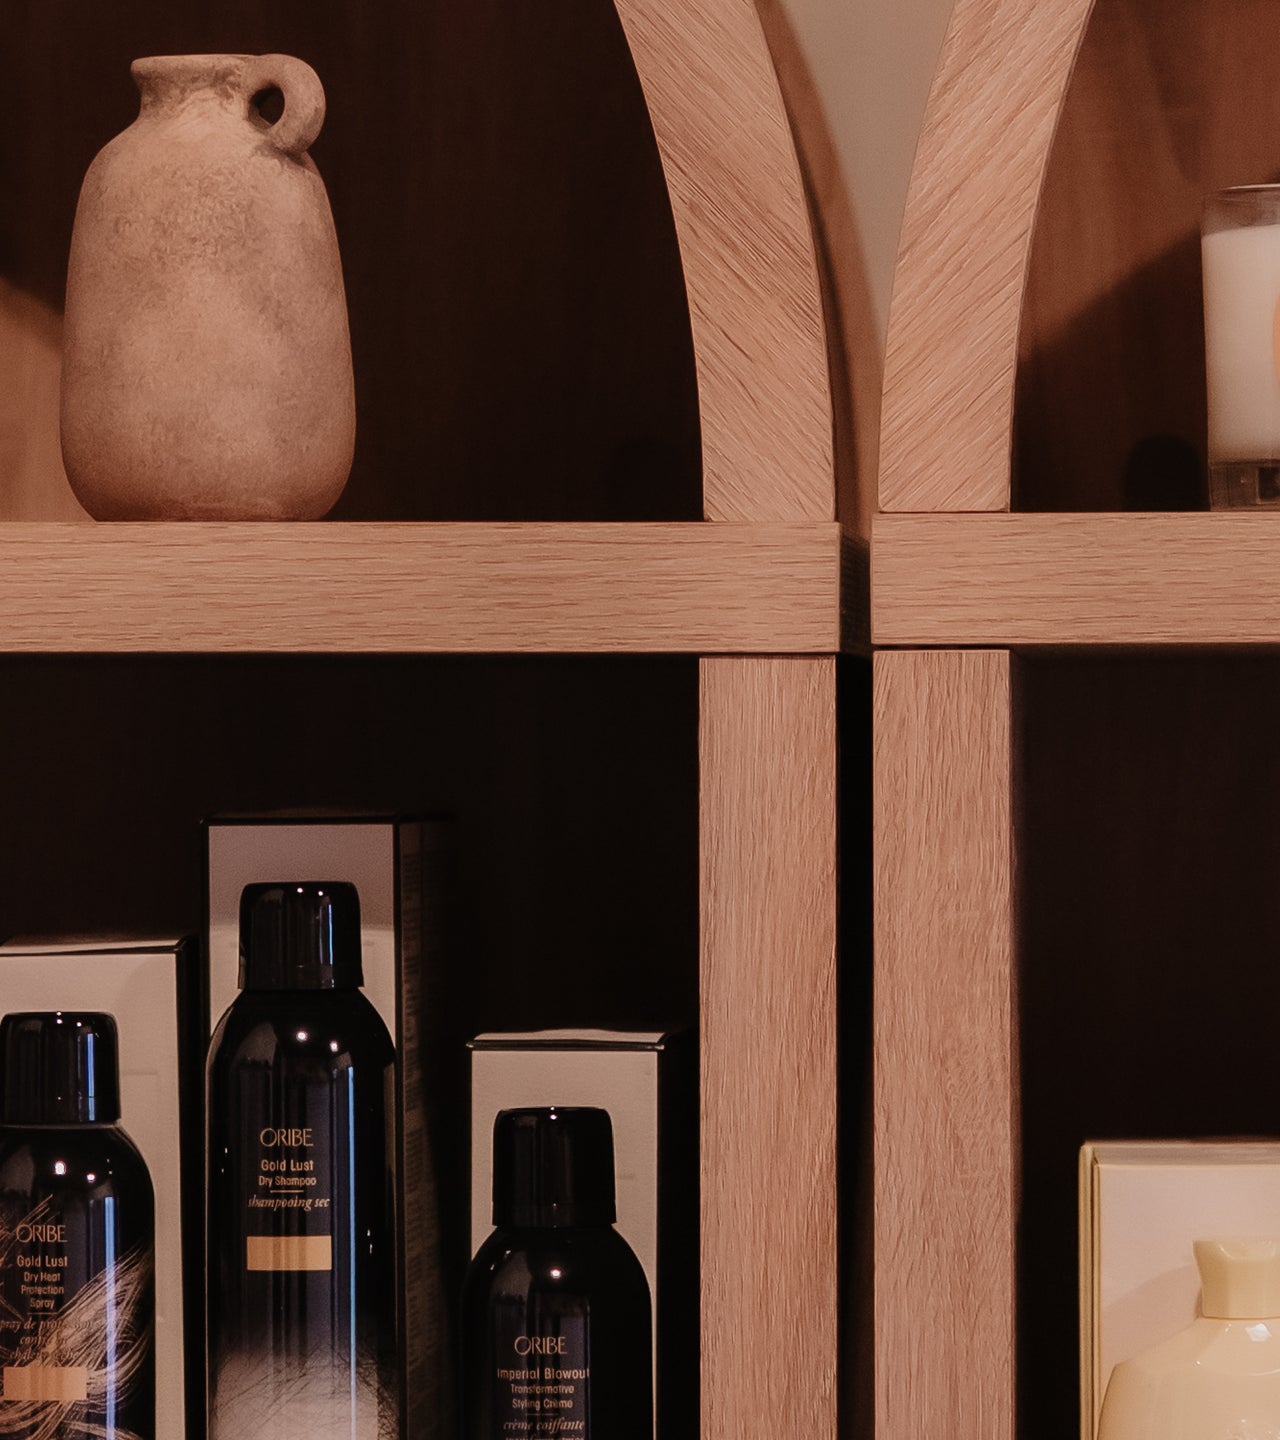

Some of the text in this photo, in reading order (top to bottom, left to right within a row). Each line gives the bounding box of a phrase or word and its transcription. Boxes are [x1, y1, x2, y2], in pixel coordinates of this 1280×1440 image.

[260, 1127, 315, 1148] ORIBE
[261, 1159, 315, 1172] Gold Lust
[258, 1175, 317, 1188] Dry Shampoo
[247, 1193, 331, 1212] shampooing sec
[16, 1224, 69, 1243] ORIBE
[16, 1255, 69, 1268] Gold Lust
[23, 1271, 61, 1283] Dry Heat
[21, 1284, 65, 1295] Protection
[29, 1298, 56, 1310] Spray
[514, 1335, 568, 1356] ORIBE
[497, 1367, 590, 1381] Imperial Blowout
[511, 1383, 575, 1395] Transformative
[512, 1398, 574, 1411] Styling Crème
[503, 1416, 586, 1434] crème coiffante
